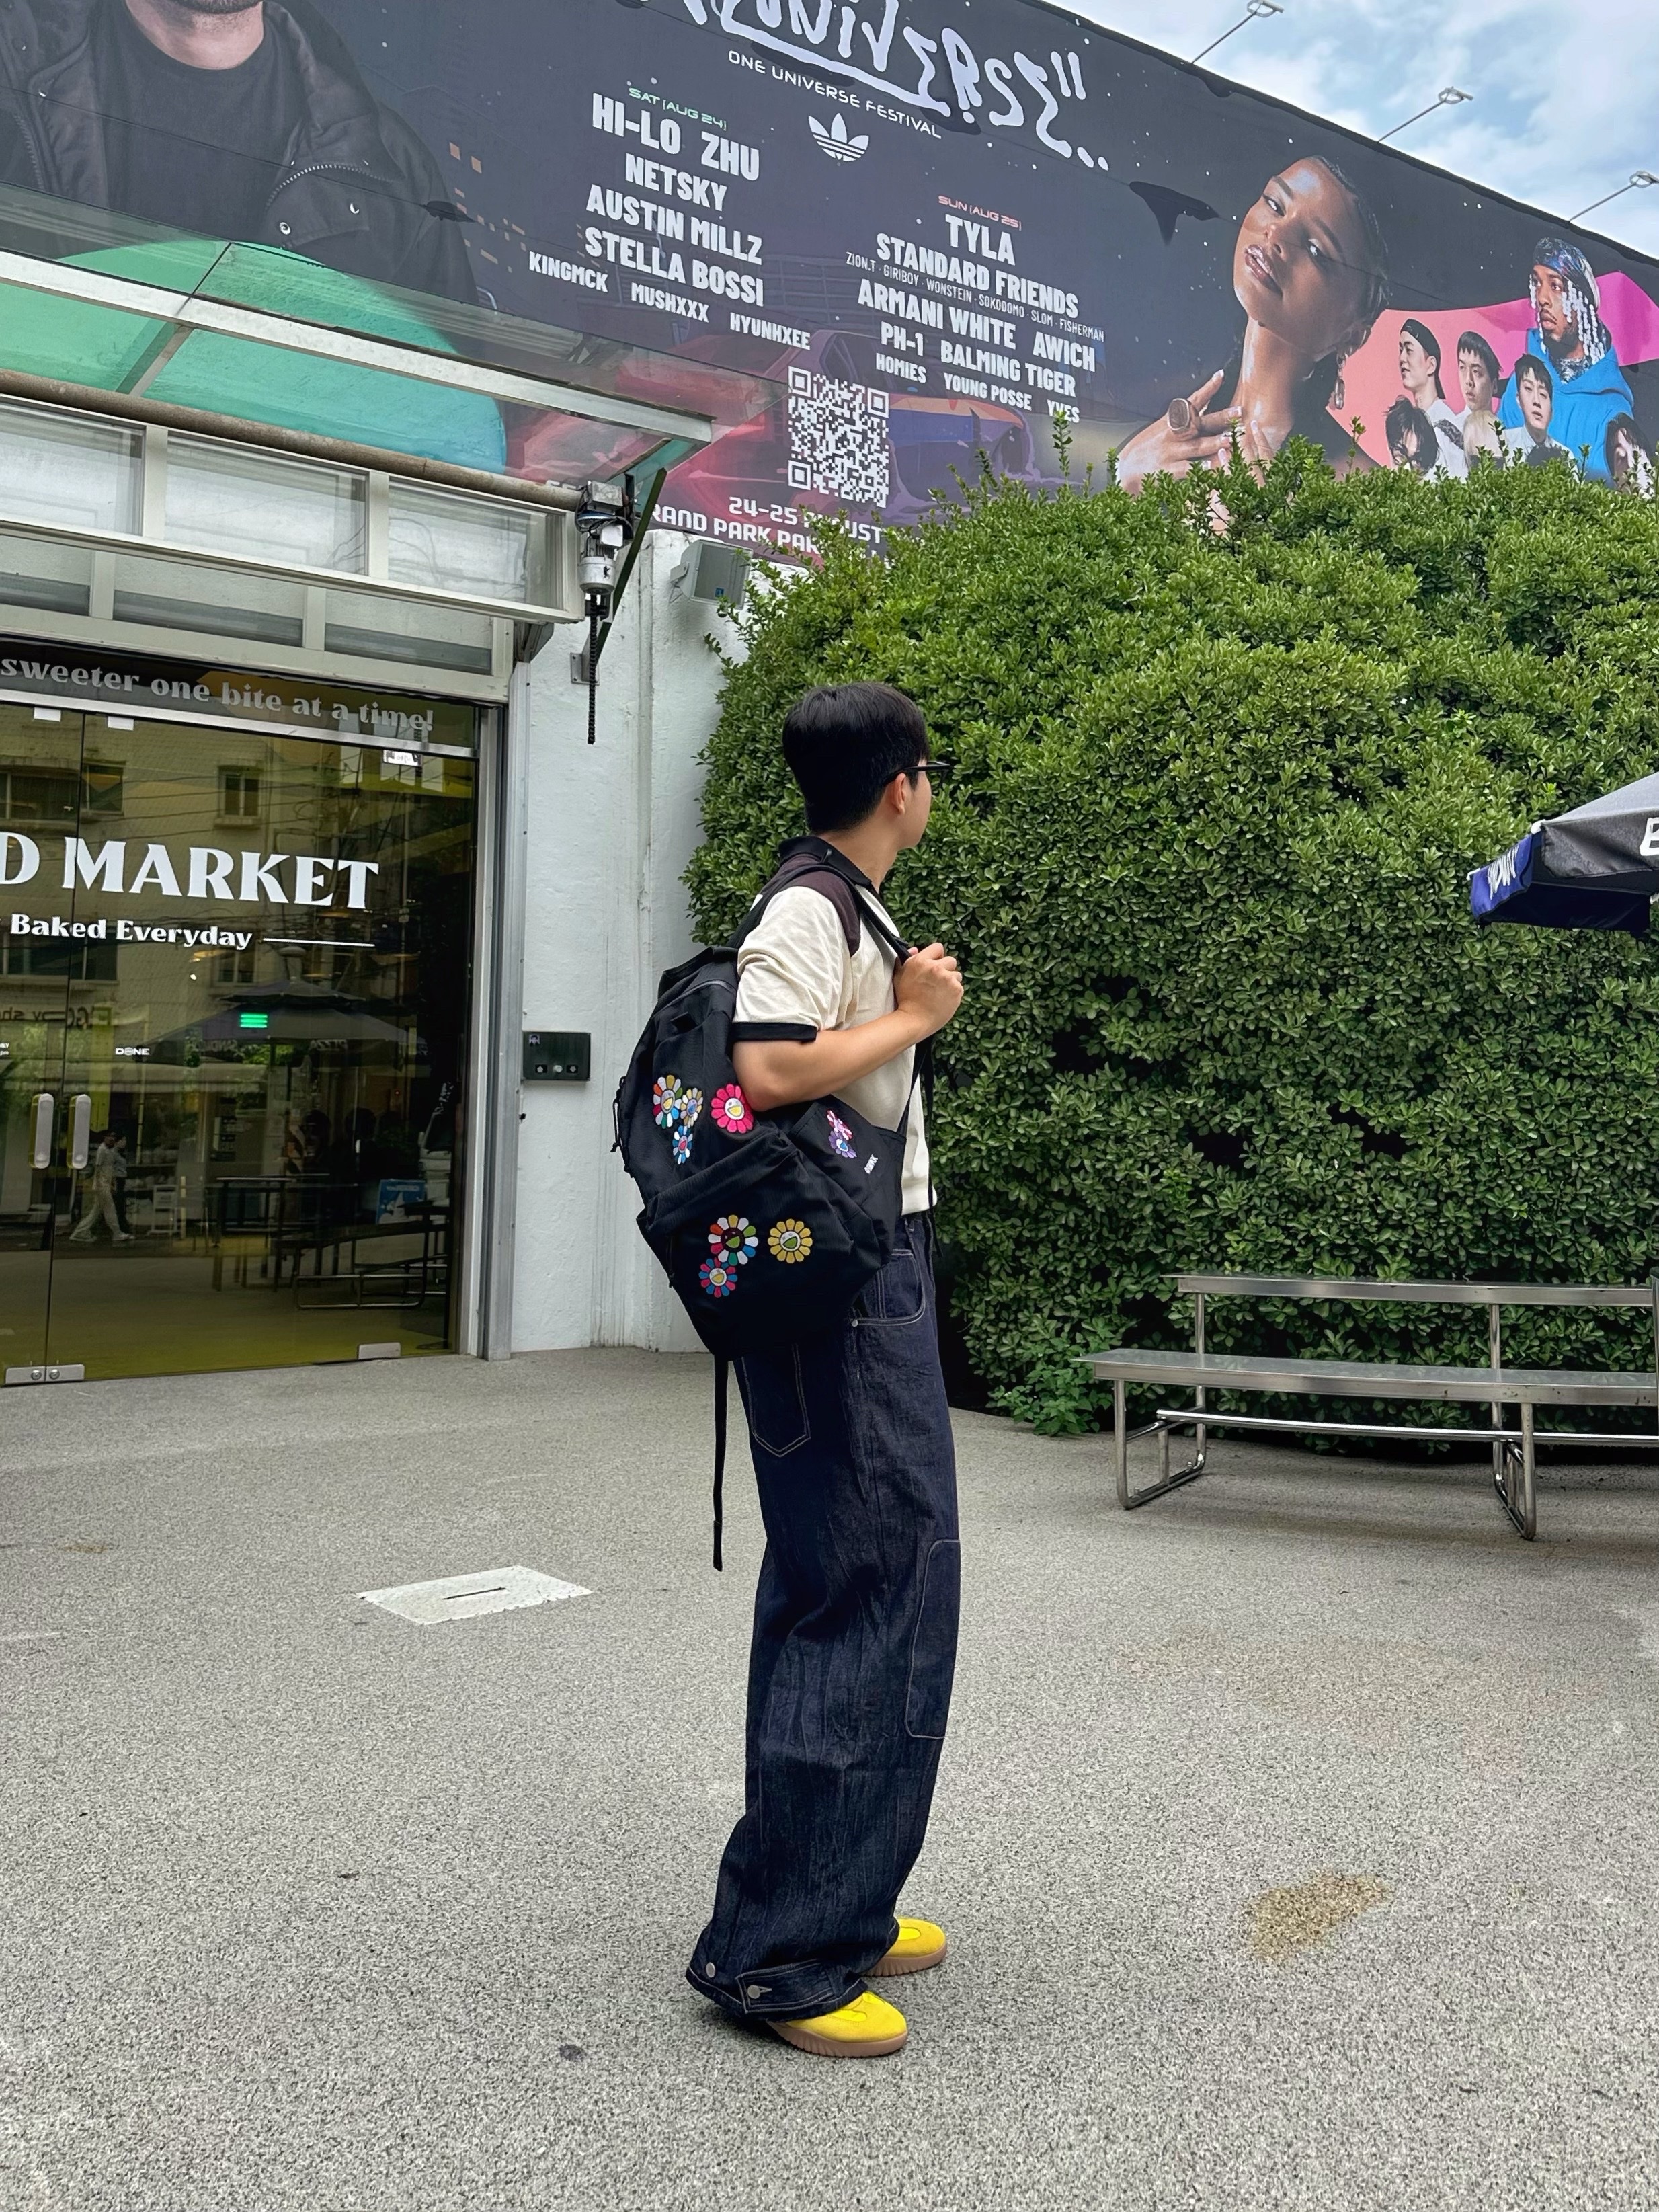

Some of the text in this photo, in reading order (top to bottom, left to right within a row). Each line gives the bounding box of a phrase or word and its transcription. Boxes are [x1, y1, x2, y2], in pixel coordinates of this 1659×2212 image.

[629, 88, 660, 106] SAT
[729, 50, 941, 139] ONE UNIVERSE FESTIVAL
[592, 93, 760, 181] HI-LO ZHU
[625, 153, 727, 211] NETSKY
[938, 195, 967, 211] SUN
[586, 184, 762, 265] AUSTIN MILLZ
[945, 214, 1015, 266] TYLA
[529, 251, 811, 350] KINGMCK MUSHXXX HYUNHXEE
[585, 227, 763, 307] STELLA BOSSI
[846, 252, 1104, 342] ZION.T GIRIBOY WONSTEIN SOKODOMO SLOM FISHERMAN
[876, 233, 1078, 318] STANDARD FRIENDS
[858, 279, 1096, 372] ARMANI WHITE AWICH
[881, 321, 1076, 397] PH-1 BALMING TIGER
[876, 352, 926, 384] HOMIES
[944, 372, 987, 399] YOUNG
[991, 385, 1032, 411] POSSE
[651, 504, 706, 532] RAND
[713, 518, 770, 542] PARK
[729, 496, 797, 525] 24-25
[1, 658, 434, 731] sweeter one bite at a time!
[62, 836, 379, 909] MARKET
[11, 913, 252, 950] Baked Everyday
